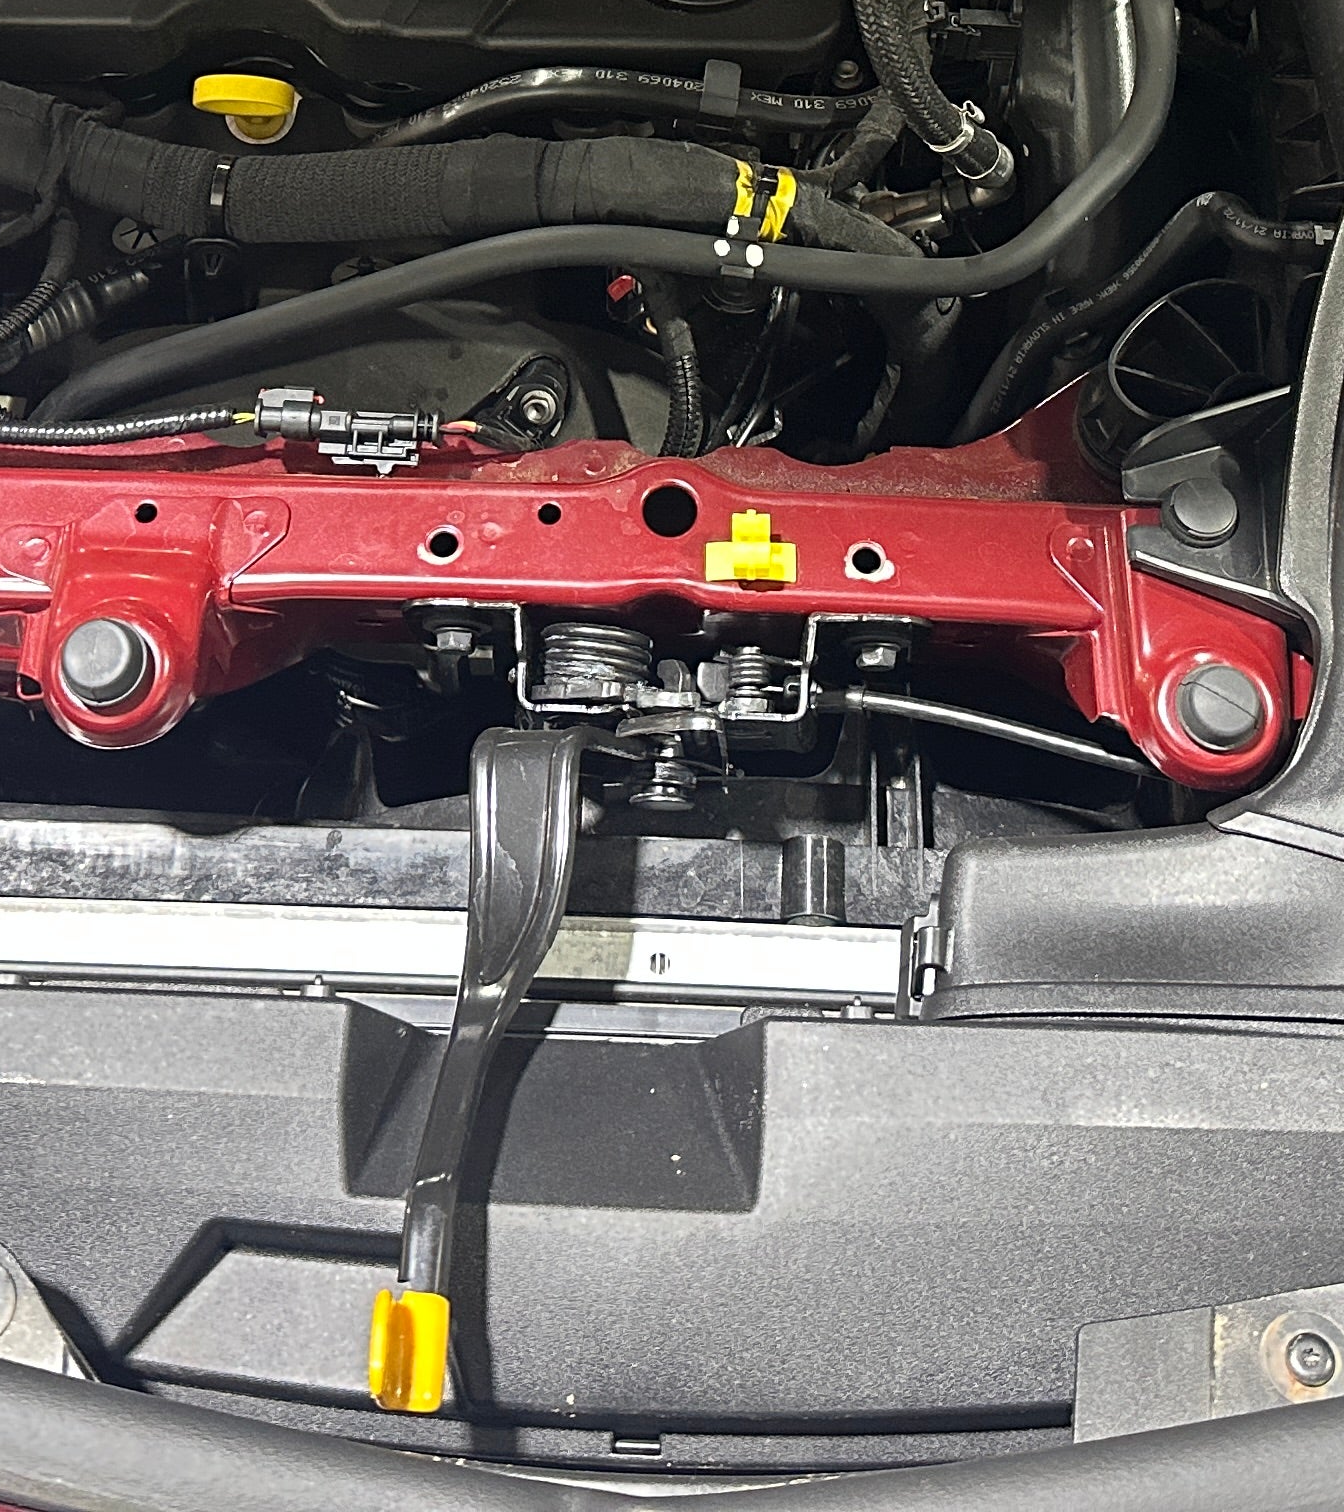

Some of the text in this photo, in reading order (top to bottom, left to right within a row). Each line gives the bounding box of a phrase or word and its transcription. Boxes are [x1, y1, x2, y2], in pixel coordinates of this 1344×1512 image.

[594, 68, 629, 82] 310
[750, 90, 784, 107] MEX
[793, 97, 826, 111] 310
[1052, 311, 1067, 326] IN
[1014, 321, 1052, 366] SLOVAKIA
